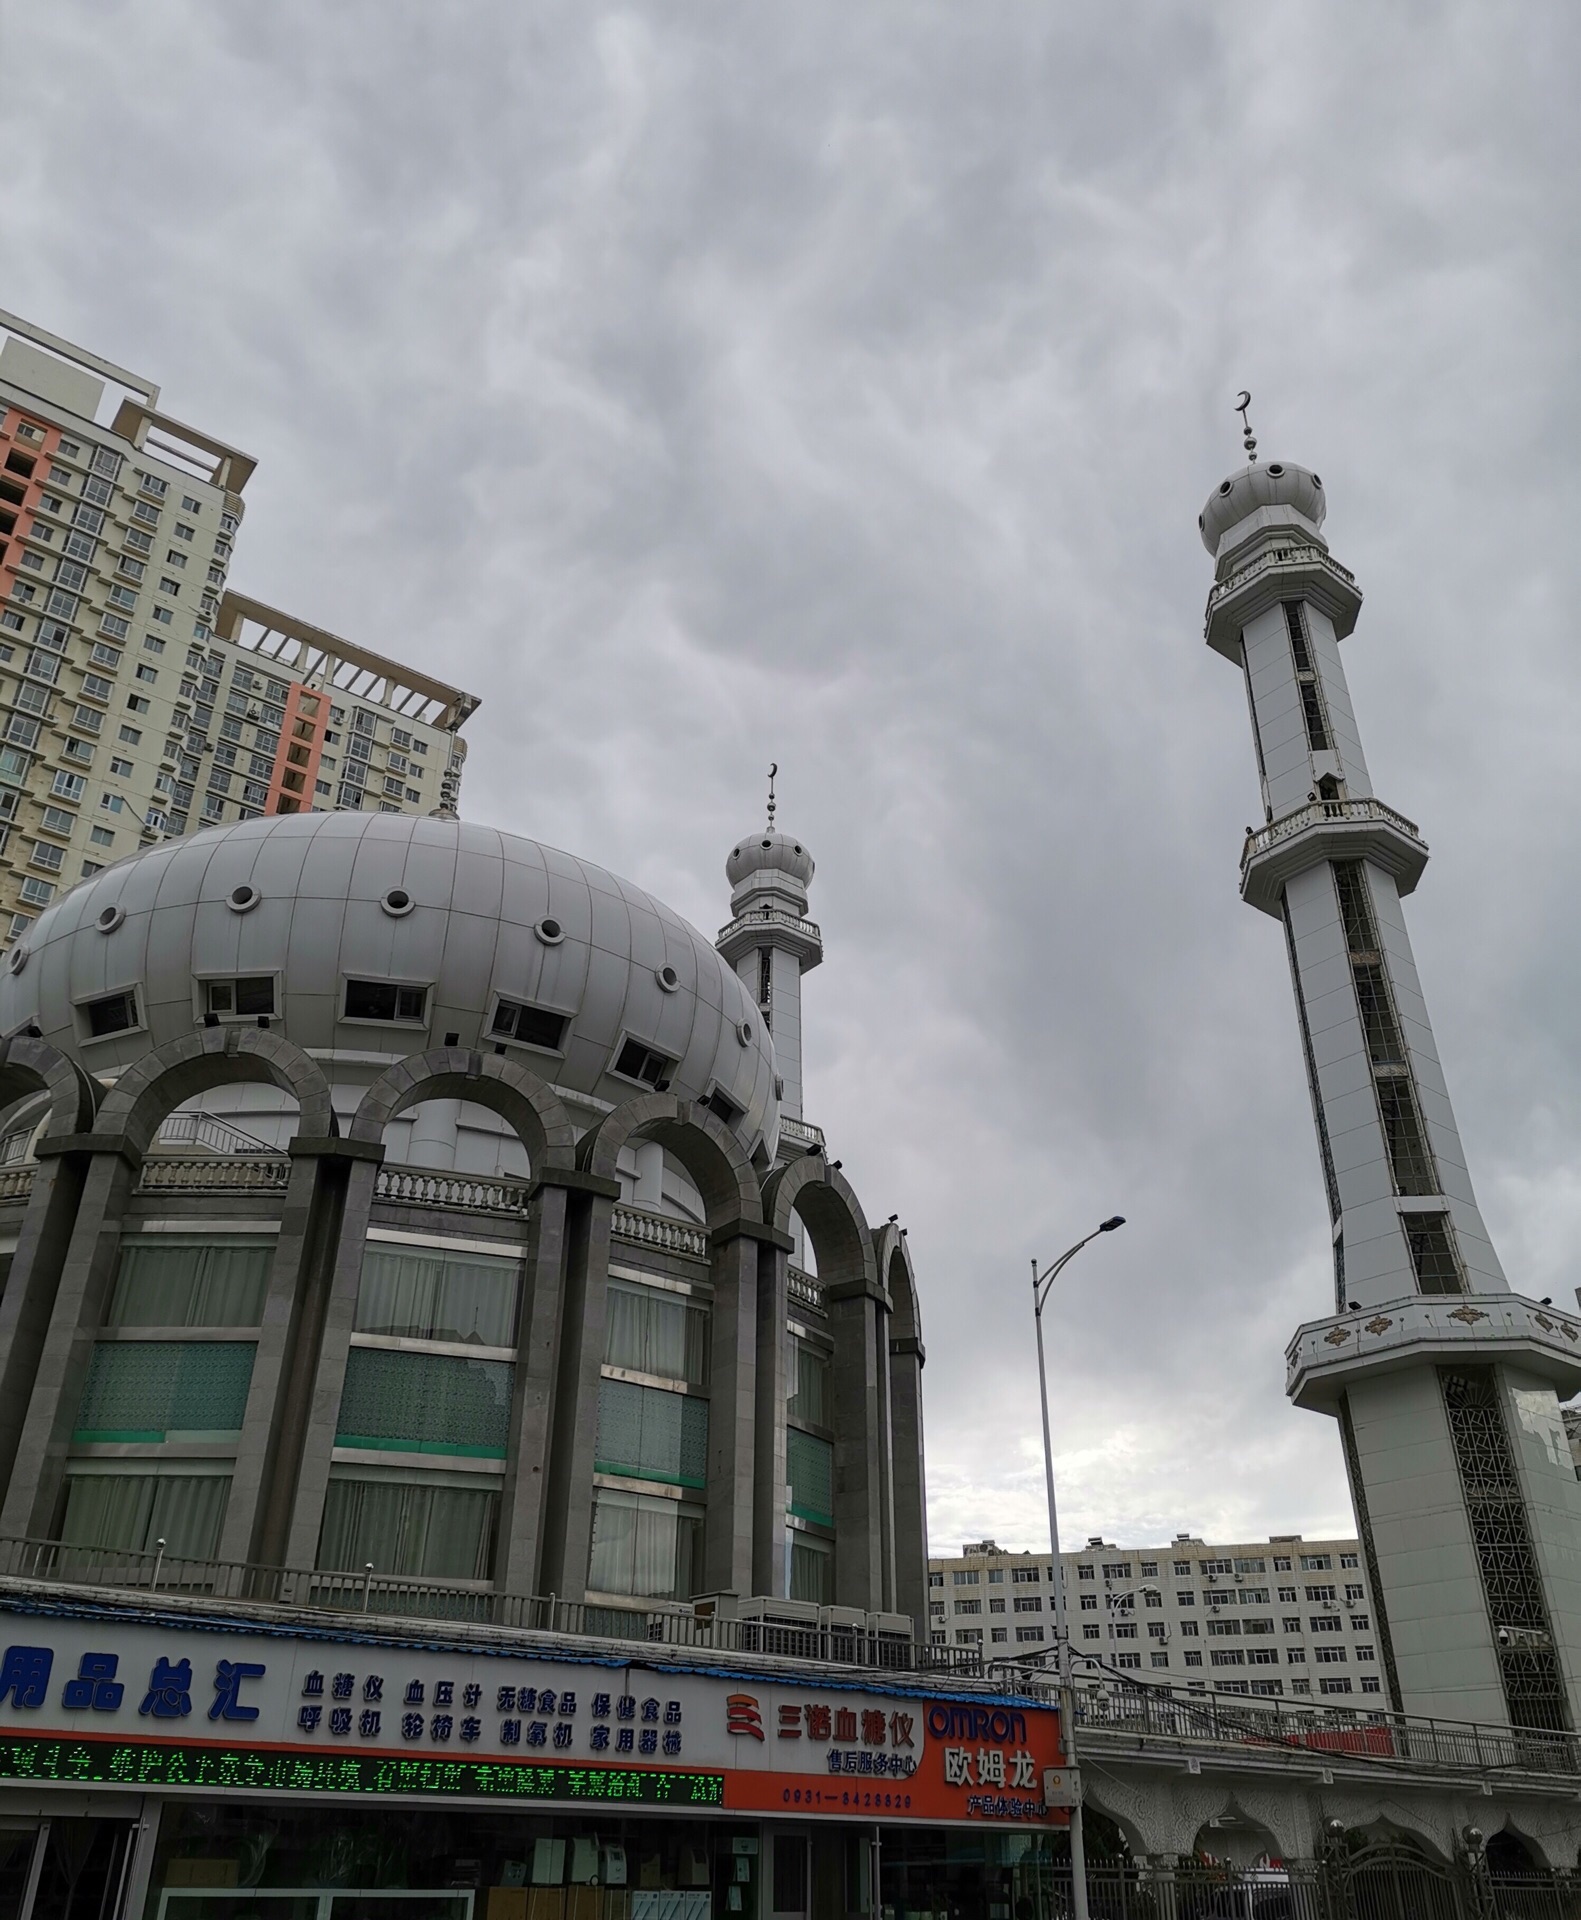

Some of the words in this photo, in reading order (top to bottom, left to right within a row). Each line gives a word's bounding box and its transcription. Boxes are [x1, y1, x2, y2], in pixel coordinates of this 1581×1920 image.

[0, 1645, 266, 1721] 用品总汇
[302, 1669, 385, 1702] 血糖仪
[404, 1678, 483, 1710] 血压计
[497, 1685, 578, 1716] 无糖食品
[591, 1692, 683, 1725] 保健食品
[297, 1705, 382, 1737] 呼吸机
[402, 1711, 482, 1743] 轮椅车
[500, 1717, 575, 1749] 制氧机
[590, 1723, 683, 1756] 家用器械
[778, 1702, 916, 1748] 三诺血糖仪
[927, 1704, 1027, 1745] OMRON
[827, 1748, 918, 1777] 售后服务中心
[943, 1746, 1039, 1790] 欧姆龙
[966, 1794, 1049, 1818] 产品体验中心
